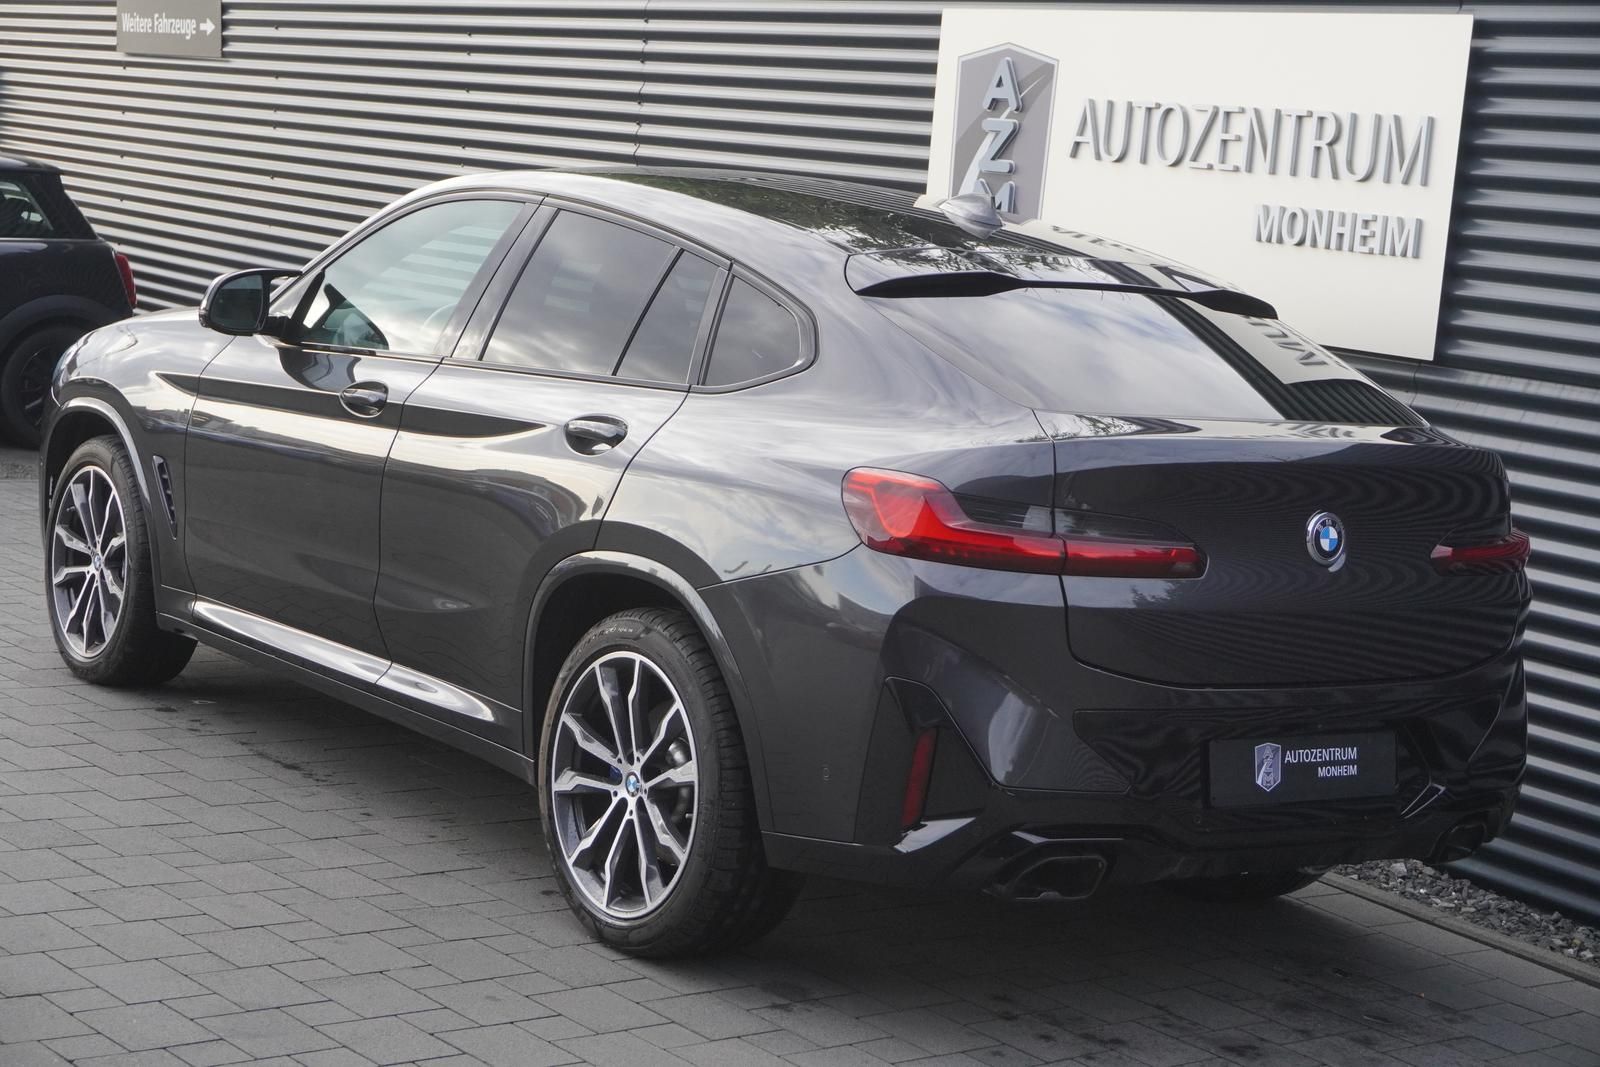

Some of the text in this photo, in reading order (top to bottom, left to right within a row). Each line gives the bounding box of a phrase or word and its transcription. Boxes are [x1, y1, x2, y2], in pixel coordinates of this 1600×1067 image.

[121, 12, 197, 40] Weitere Fahrzeuge
[1069, 98, 1434, 187] AUTOZENTRUM
[1254, 204, 1423, 259] MONHEIM
[1284, 746, 1357, 764] AUTOZENTRUM
[1317, 764, 1358, 778] MONHEIM
